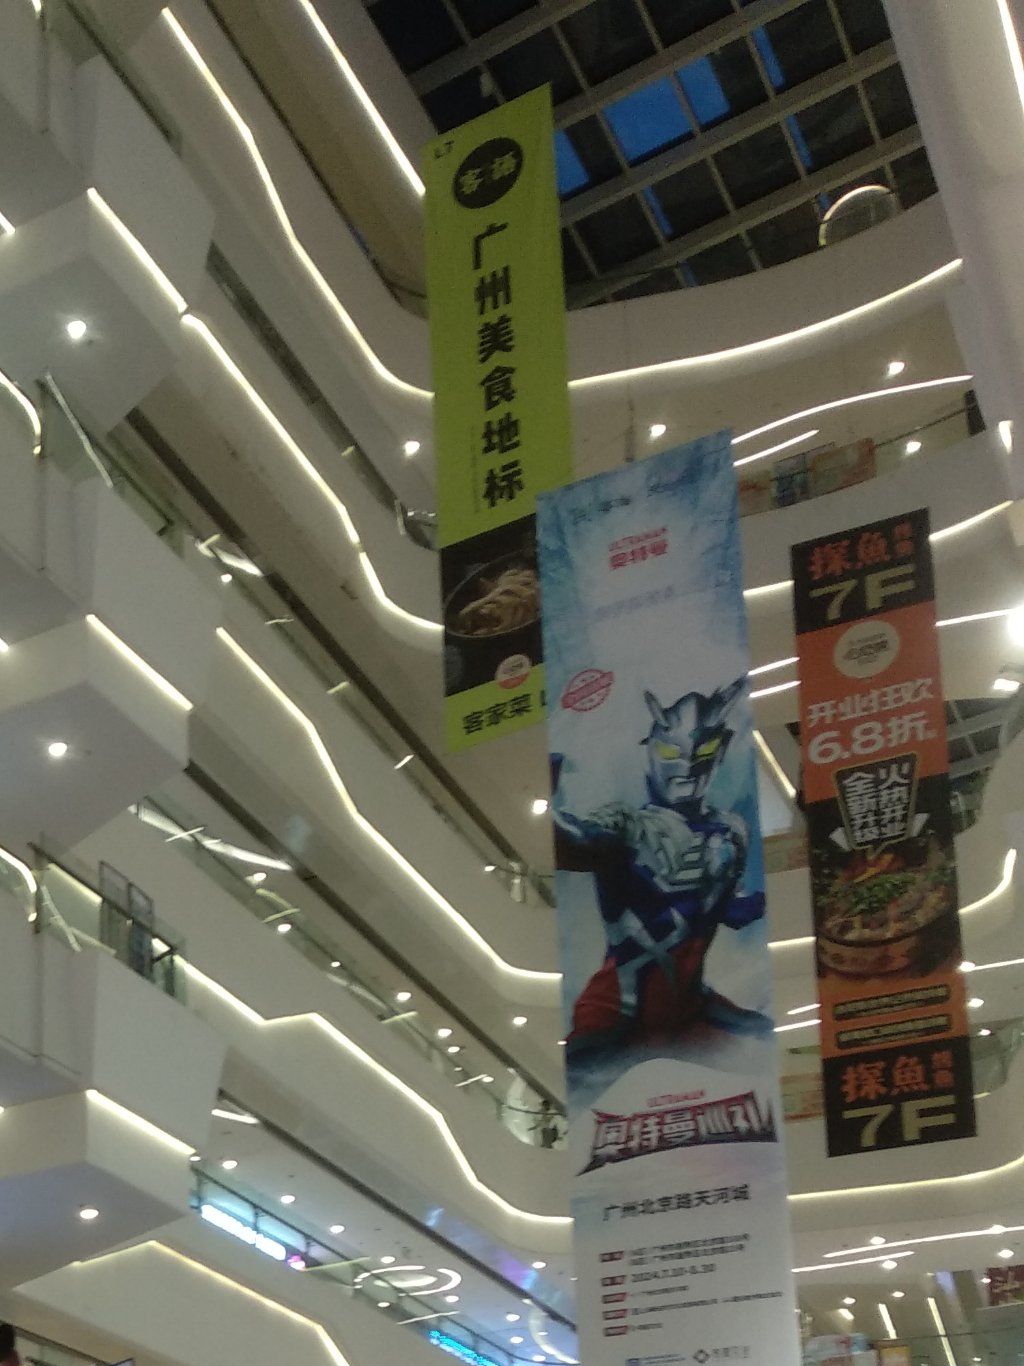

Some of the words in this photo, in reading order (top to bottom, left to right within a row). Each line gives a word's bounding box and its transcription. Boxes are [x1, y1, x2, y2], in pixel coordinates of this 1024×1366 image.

[472, 221, 523, 508] 广州美食地标
[809, 564, 915, 620] 7F
[843, 1095, 957, 1148] 7F
